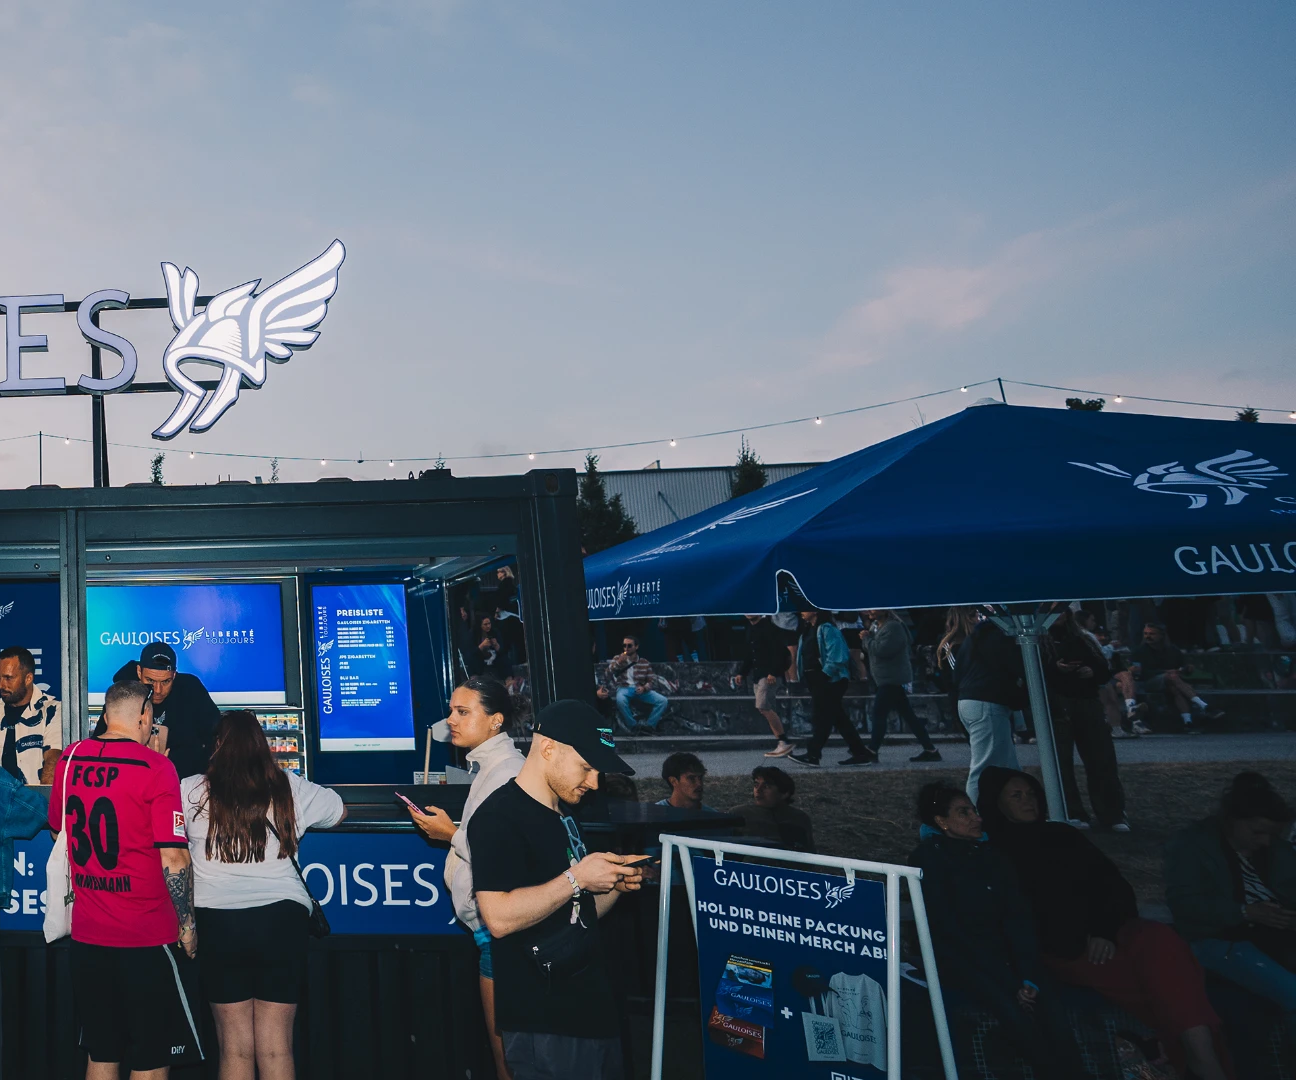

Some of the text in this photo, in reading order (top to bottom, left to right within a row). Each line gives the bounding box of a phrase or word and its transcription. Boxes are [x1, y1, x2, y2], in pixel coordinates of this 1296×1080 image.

[336, 608, 384, 617] PREISLISTE
[100, 631, 180, 646] GAULOISES
[205, 628, 254, 637] LIBERTÉ
[320, 657, 333, 714] GAULOISES
[71, 765, 119, 788] FCSP
[65, 794, 121, 871] 30
[302, 862, 439, 907] OISES
[713, 868, 822, 900] GAULOISES
[697, 900, 886, 942] HOL DIR DEINE PACKUNG
[709, 917, 887, 960] UND DEINEN MERCH AB!
[730, 991, 772, 1008] GAULOISES
[722, 1021, 762, 1039] GAULOISES
